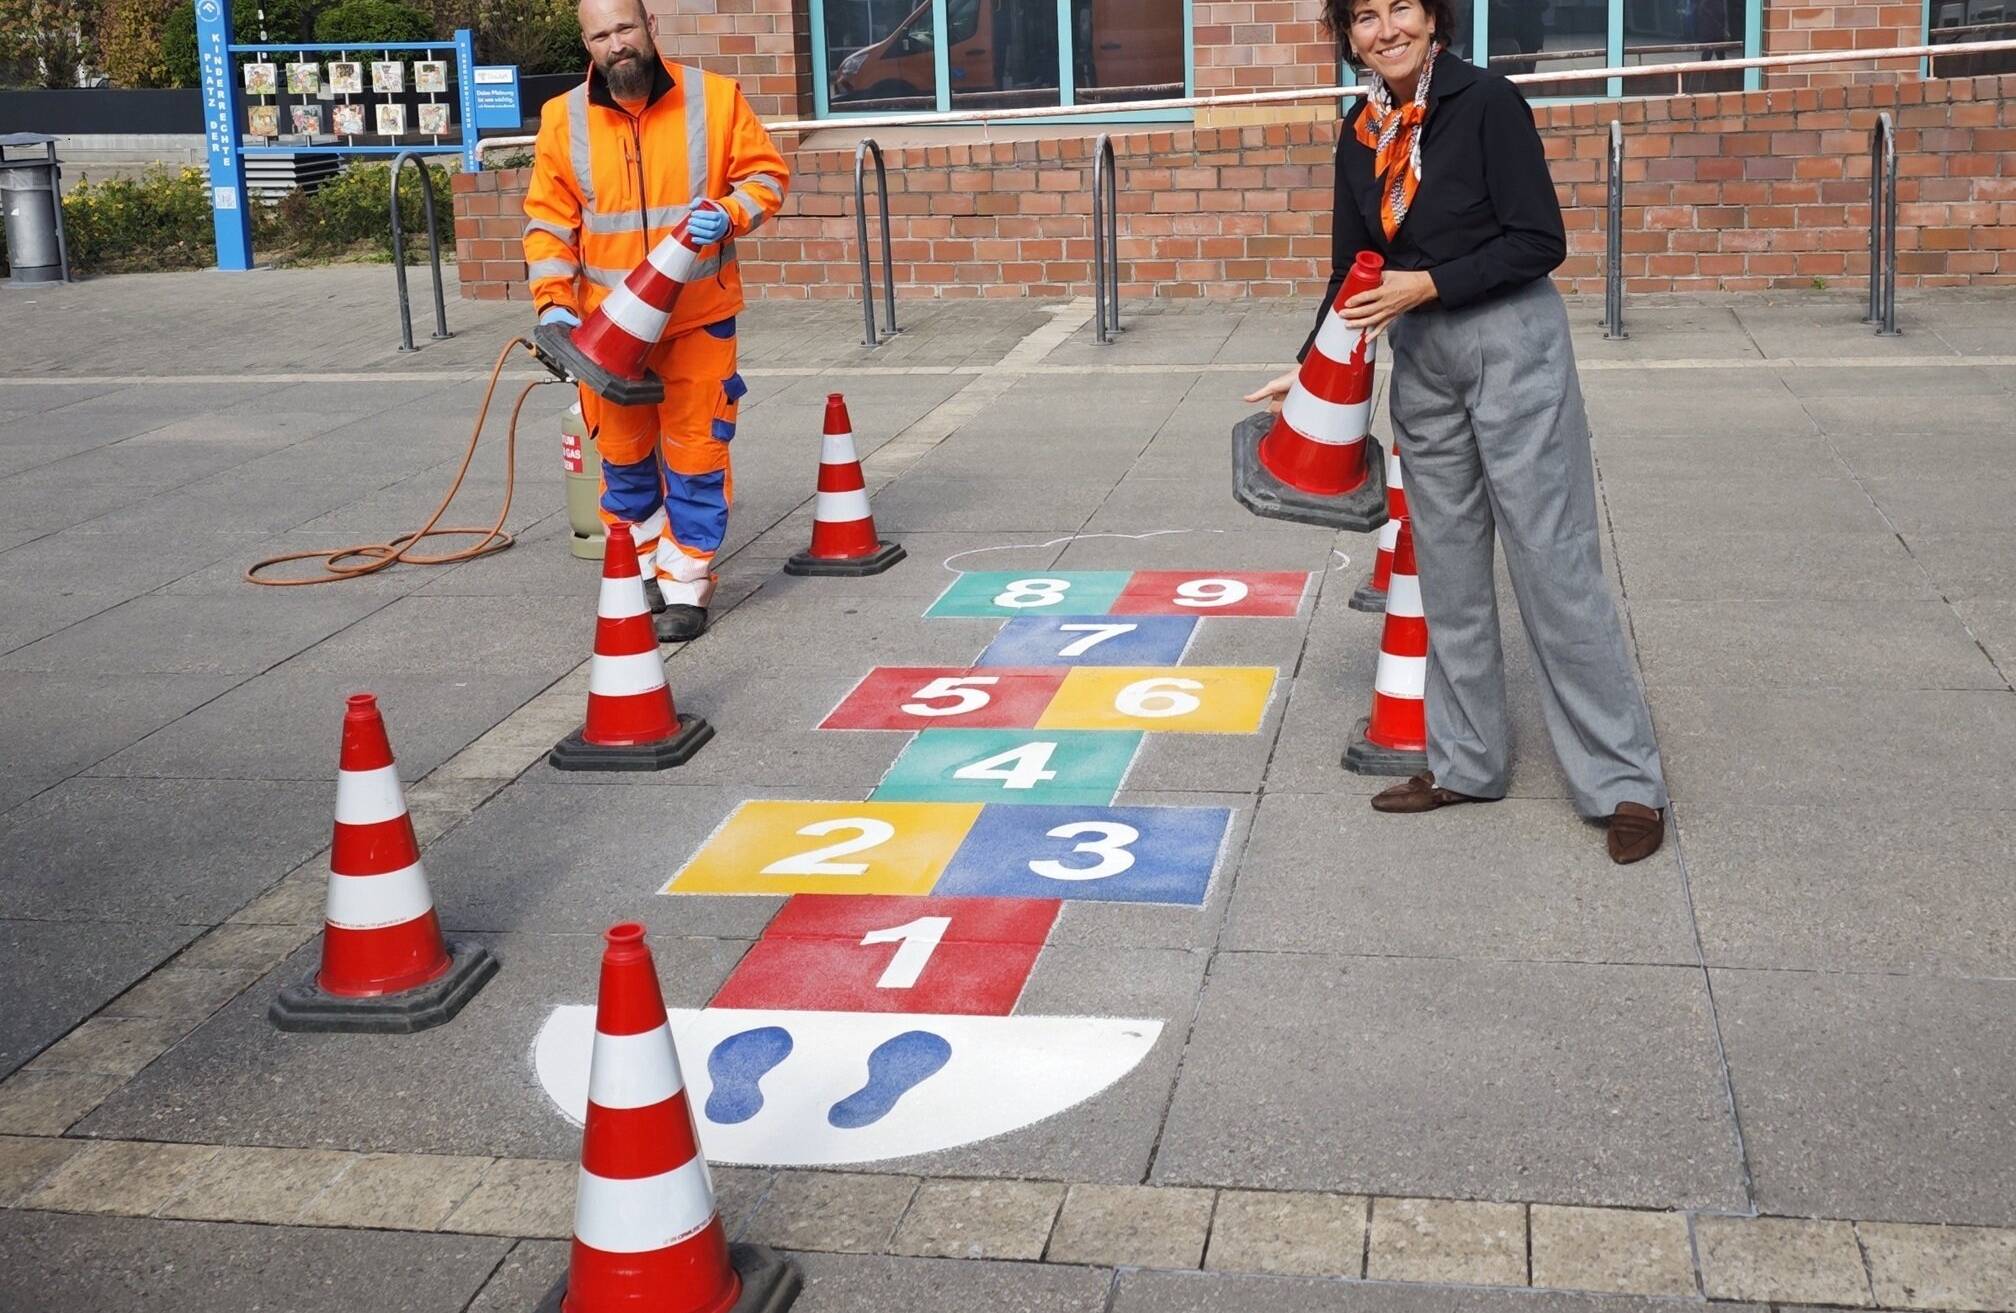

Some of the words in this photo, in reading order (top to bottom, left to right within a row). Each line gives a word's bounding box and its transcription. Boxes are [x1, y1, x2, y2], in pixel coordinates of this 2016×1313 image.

[204, 53, 216, 107] PLATZ
[210, 120, 220, 152] DER
[211, 33, 231, 166] KINDERRECHTE
[994, 578, 1072, 608] 8
[1173, 578, 1249, 607] 9
[1056, 623, 1138, 657] 7
[901, 676, 1000, 717] 5
[1114, 677, 1203, 718] 6
[952, 741, 1058, 790] 4
[760, 818, 894, 876] 2
[1028, 821, 1139, 881] 3
[860, 916, 952, 989] 1
